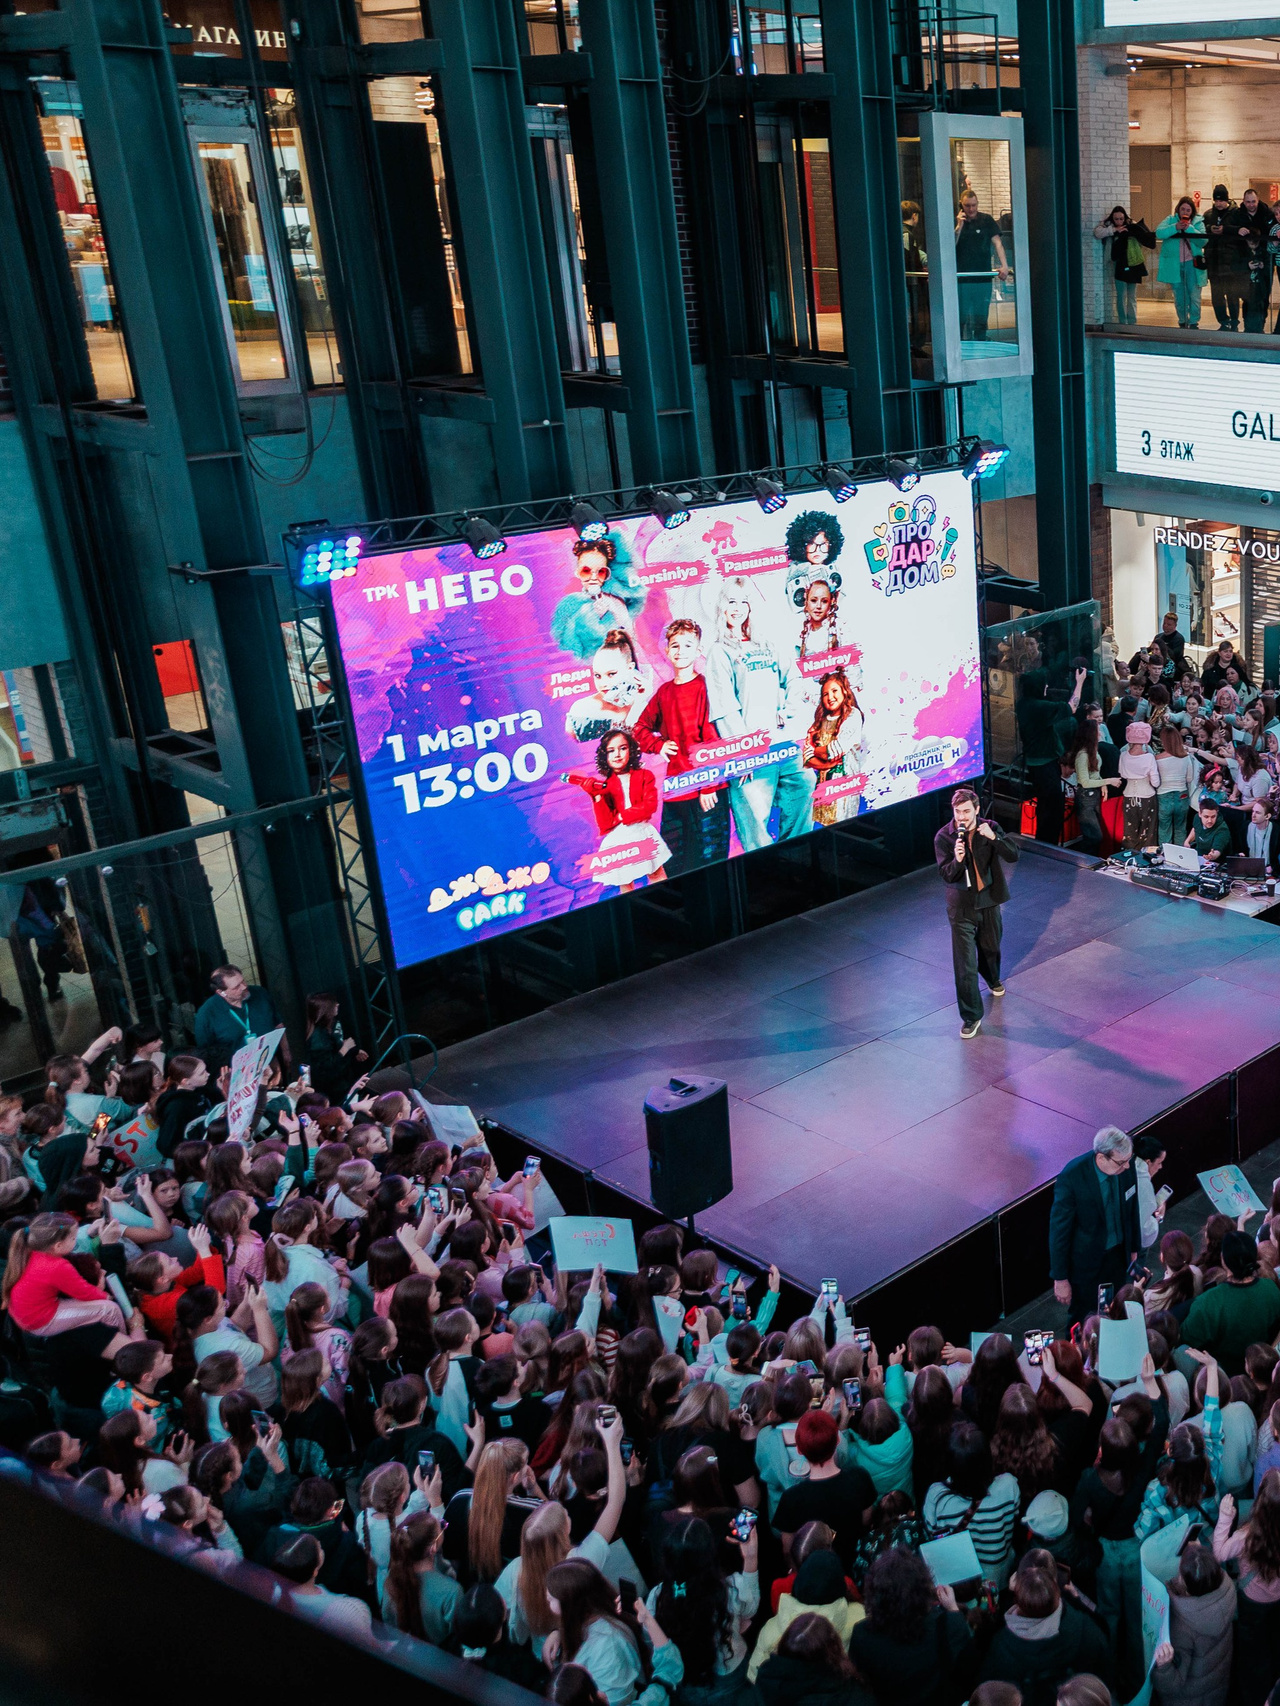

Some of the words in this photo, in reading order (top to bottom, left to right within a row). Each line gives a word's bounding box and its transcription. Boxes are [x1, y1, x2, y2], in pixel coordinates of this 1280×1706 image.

[173, 23, 287, 48] АГАИН
[1141, 430, 1151, 456] 3
[1160, 440, 1195, 462] ЭТАЖ
[892, 520, 932, 545] ПРО
[724, 554, 787, 573] Равшана
[888, 538, 936, 572] ДАР
[363, 584, 399, 602] ТРК
[405, 564, 533, 614] НЕБО
[885, 560, 940, 597] ДОМ
[550, 668, 591, 685] Леди
[803, 652, 851, 672] Naniray
[552, 682, 590, 699] Леся
[386, 733, 406, 762] 1
[417, 709, 543, 756] марта
[393, 743, 549, 814] 13:00
[663, 768, 719, 793] Макар
[724, 746, 798, 777] Давыдов
[590, 846, 640, 870] Арика
[457, 892, 527, 931] PARK
